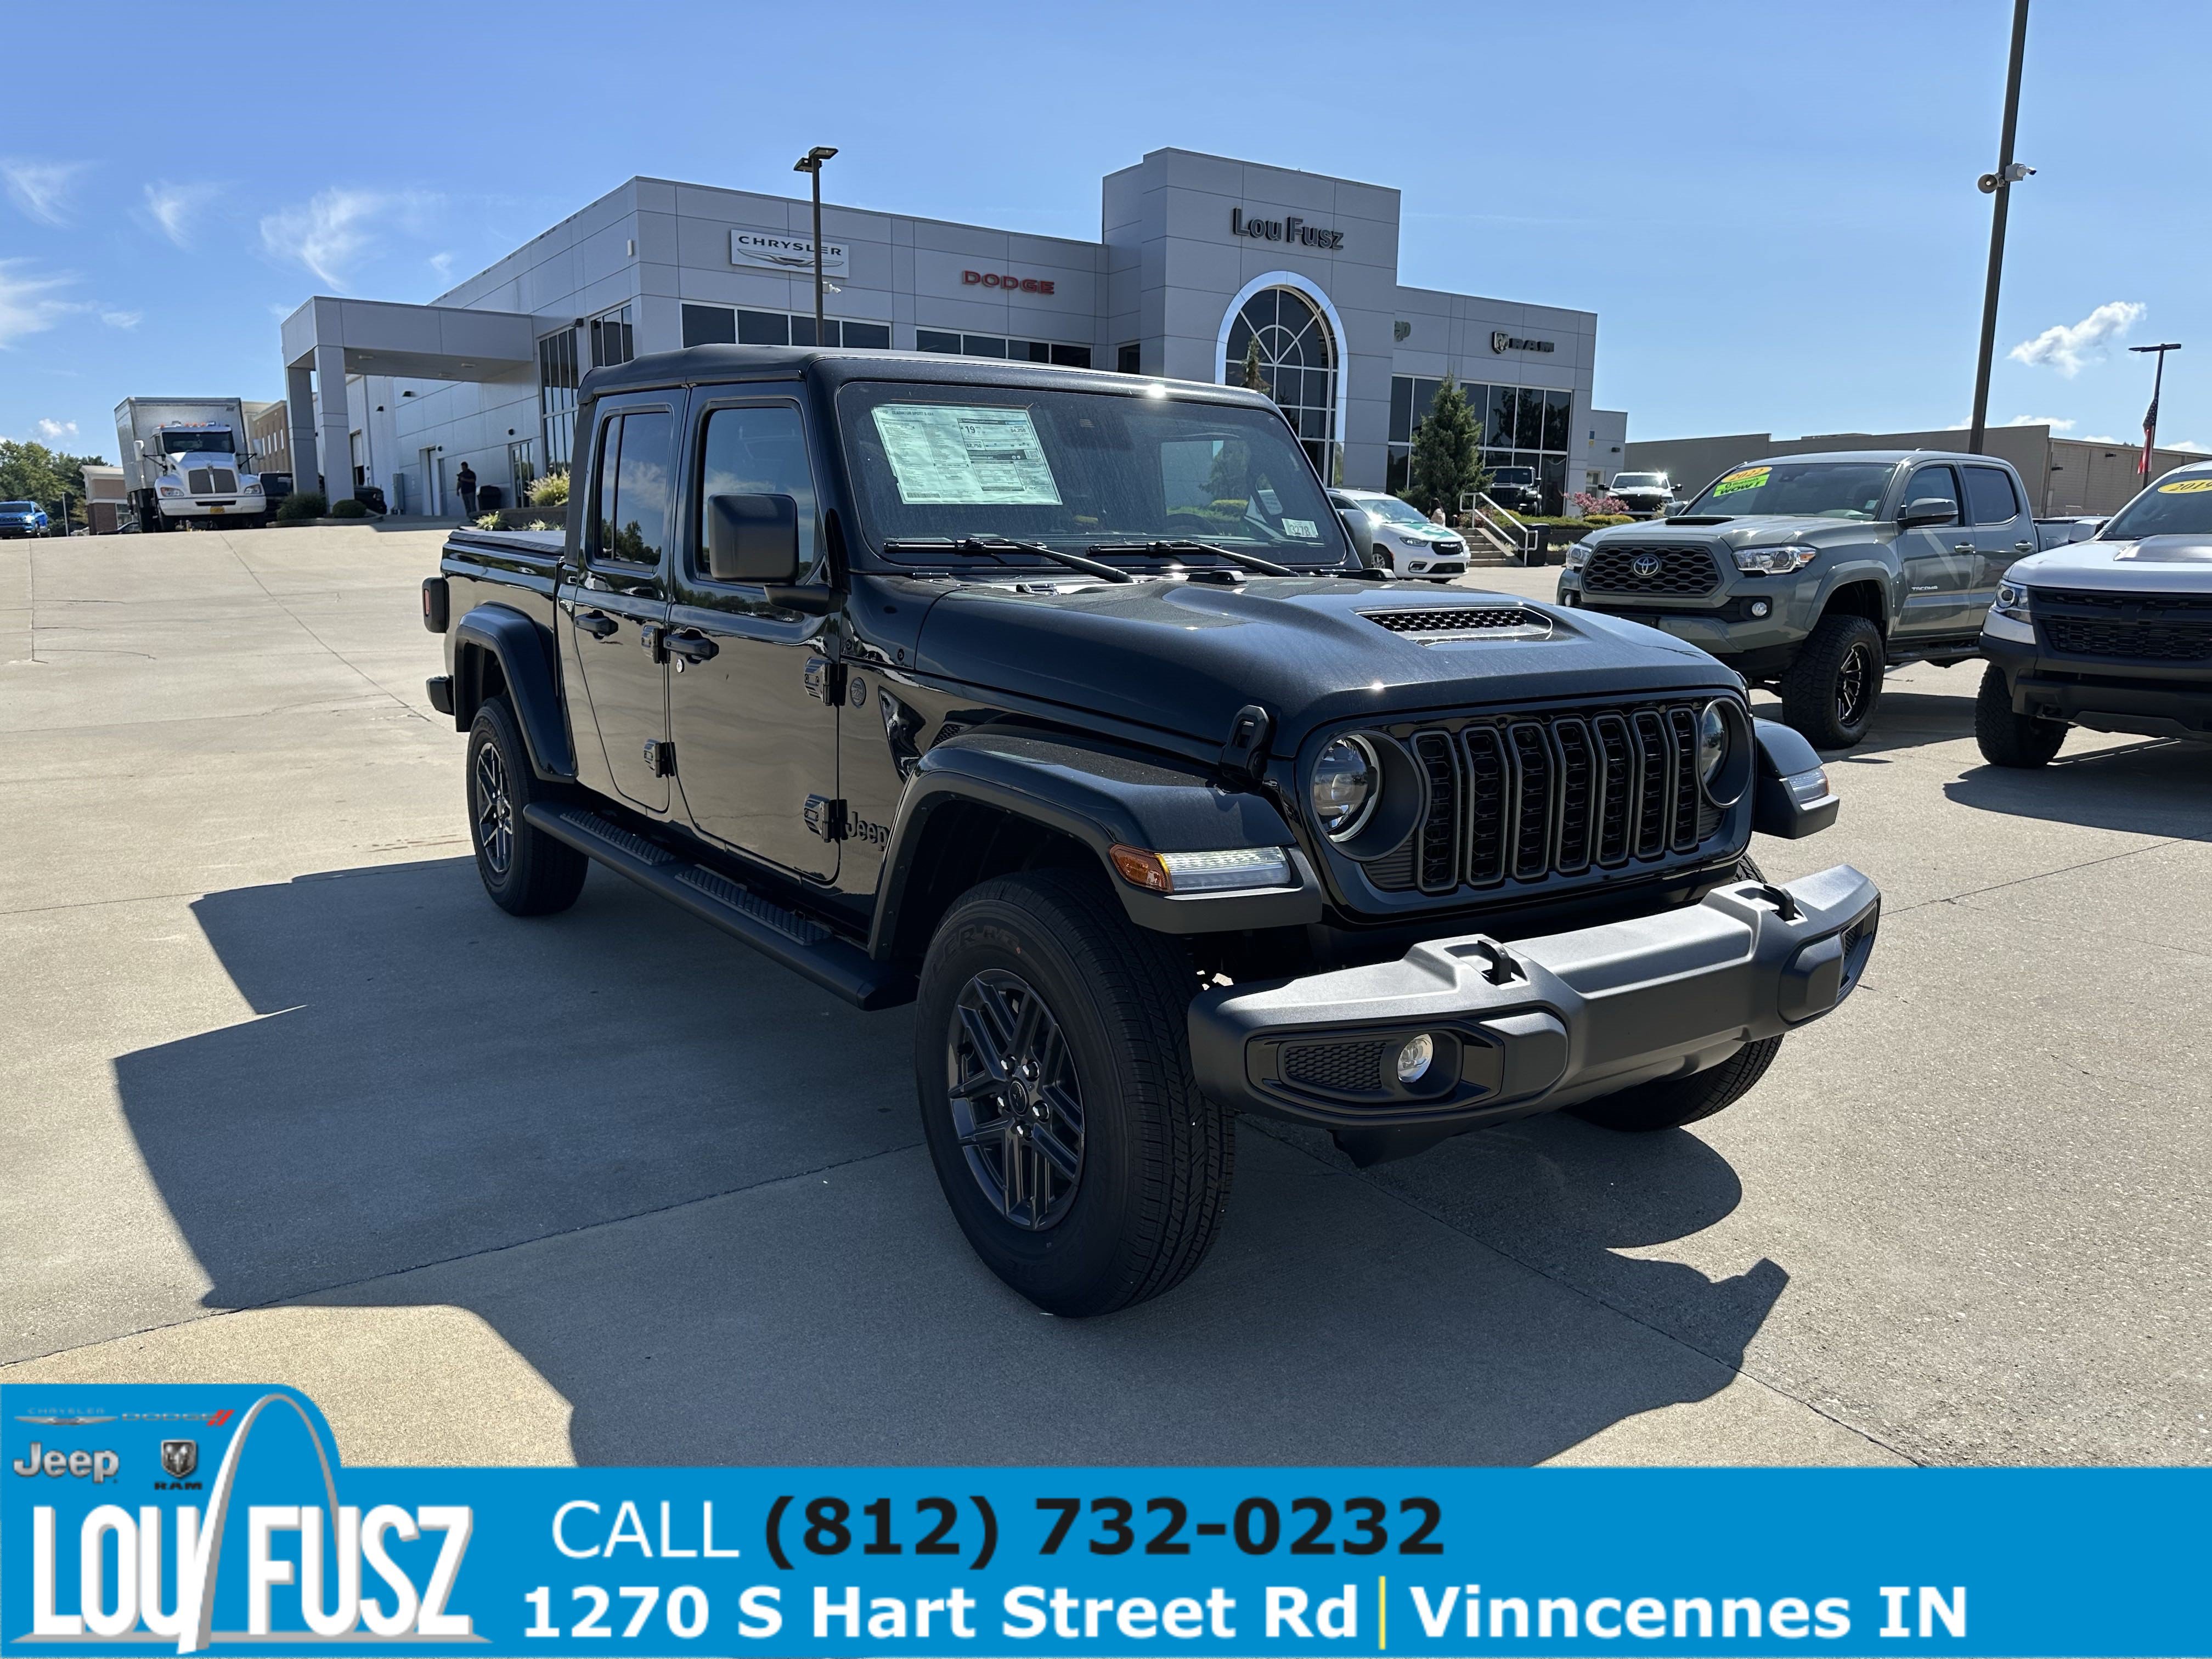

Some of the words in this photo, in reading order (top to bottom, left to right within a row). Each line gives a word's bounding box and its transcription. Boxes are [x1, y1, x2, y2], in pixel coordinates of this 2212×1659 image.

[1233, 207, 1282, 241] Lou
[1286, 216, 1344, 250] Fusz
[738, 236, 842, 256] CHRYSLER
[962, 270, 1055, 295] DODGE
[1509, 338, 1555, 352] RAM
[1289, 524, 1311, 536] 3278
[845, 811, 890, 852] Jeep
